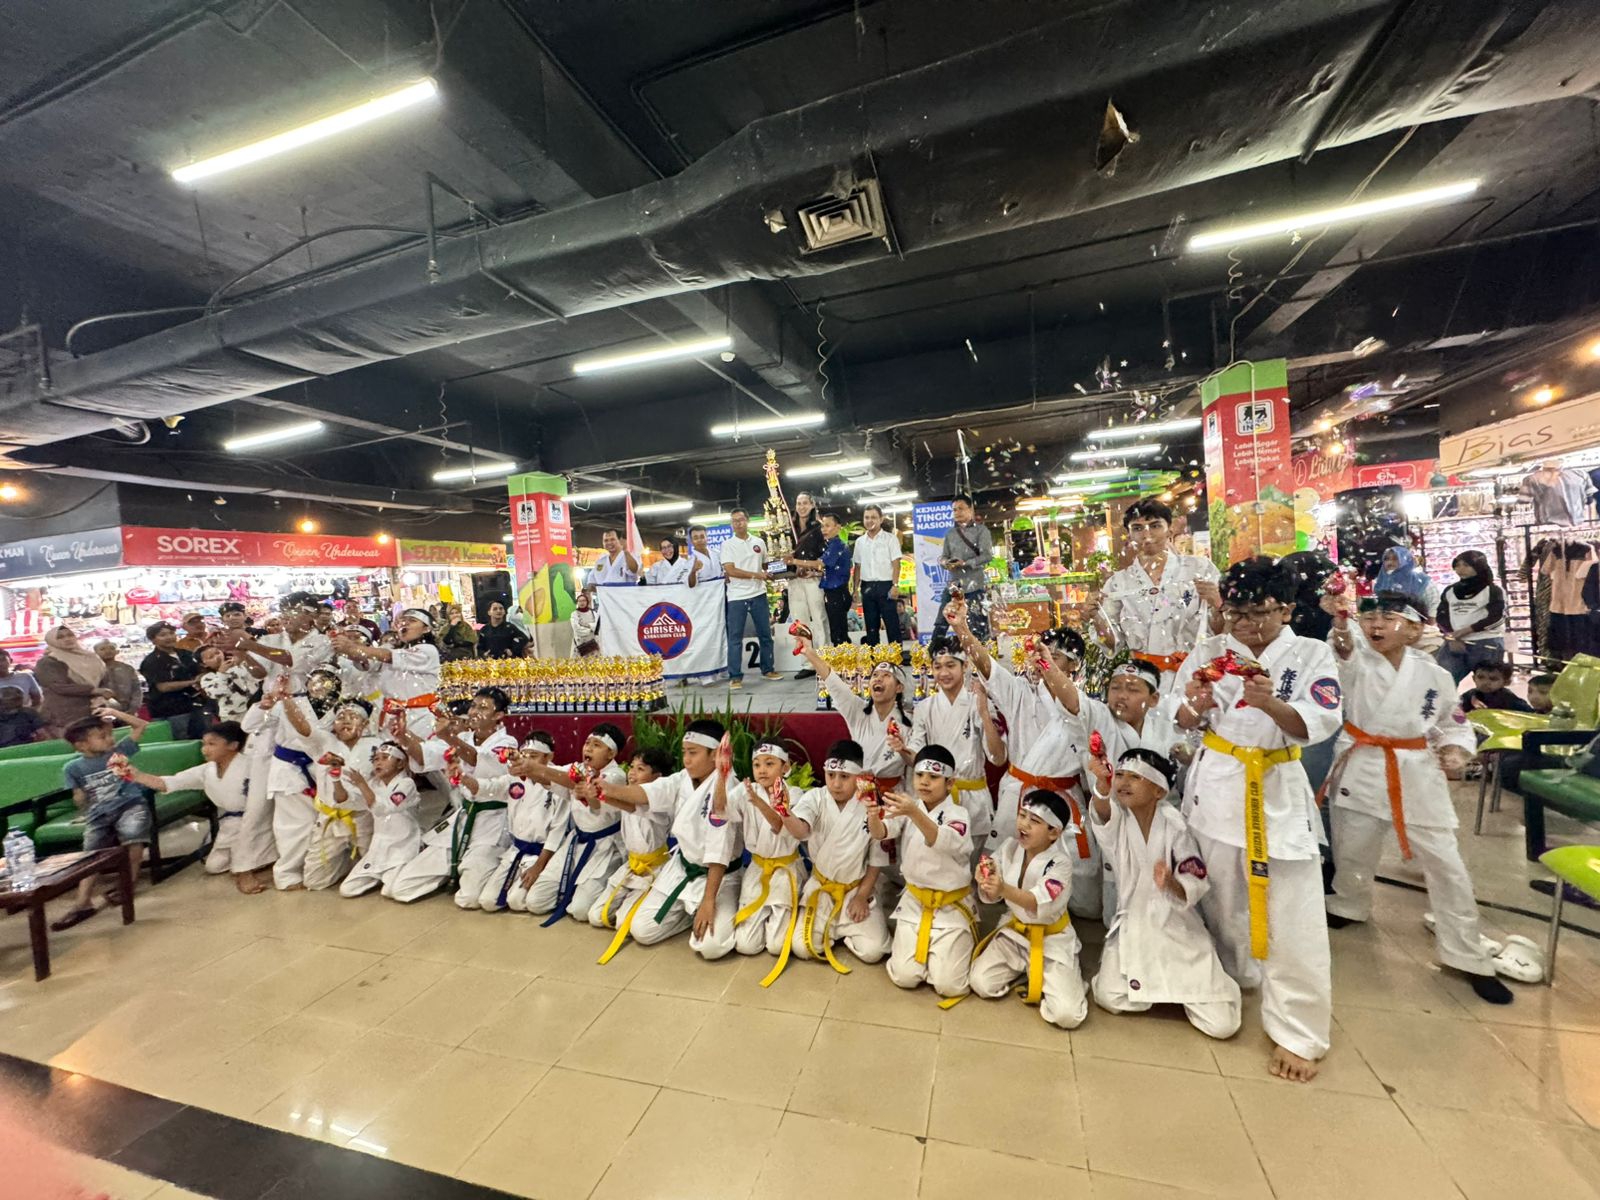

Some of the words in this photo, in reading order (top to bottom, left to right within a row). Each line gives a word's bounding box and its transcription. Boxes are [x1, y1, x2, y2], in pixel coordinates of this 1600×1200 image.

[915, 504, 953, 513] KEJUARA
[916, 511, 954, 522] TINGKA
[916, 520, 954, 530] NASION
[157, 536, 239, 554] SOREX
[273, 540, 320, 561] Queen
[320, 542, 380, 560] Underwear
[643, 625, 686, 635] GIRISENA
[745, 641, 760, 669] 2
